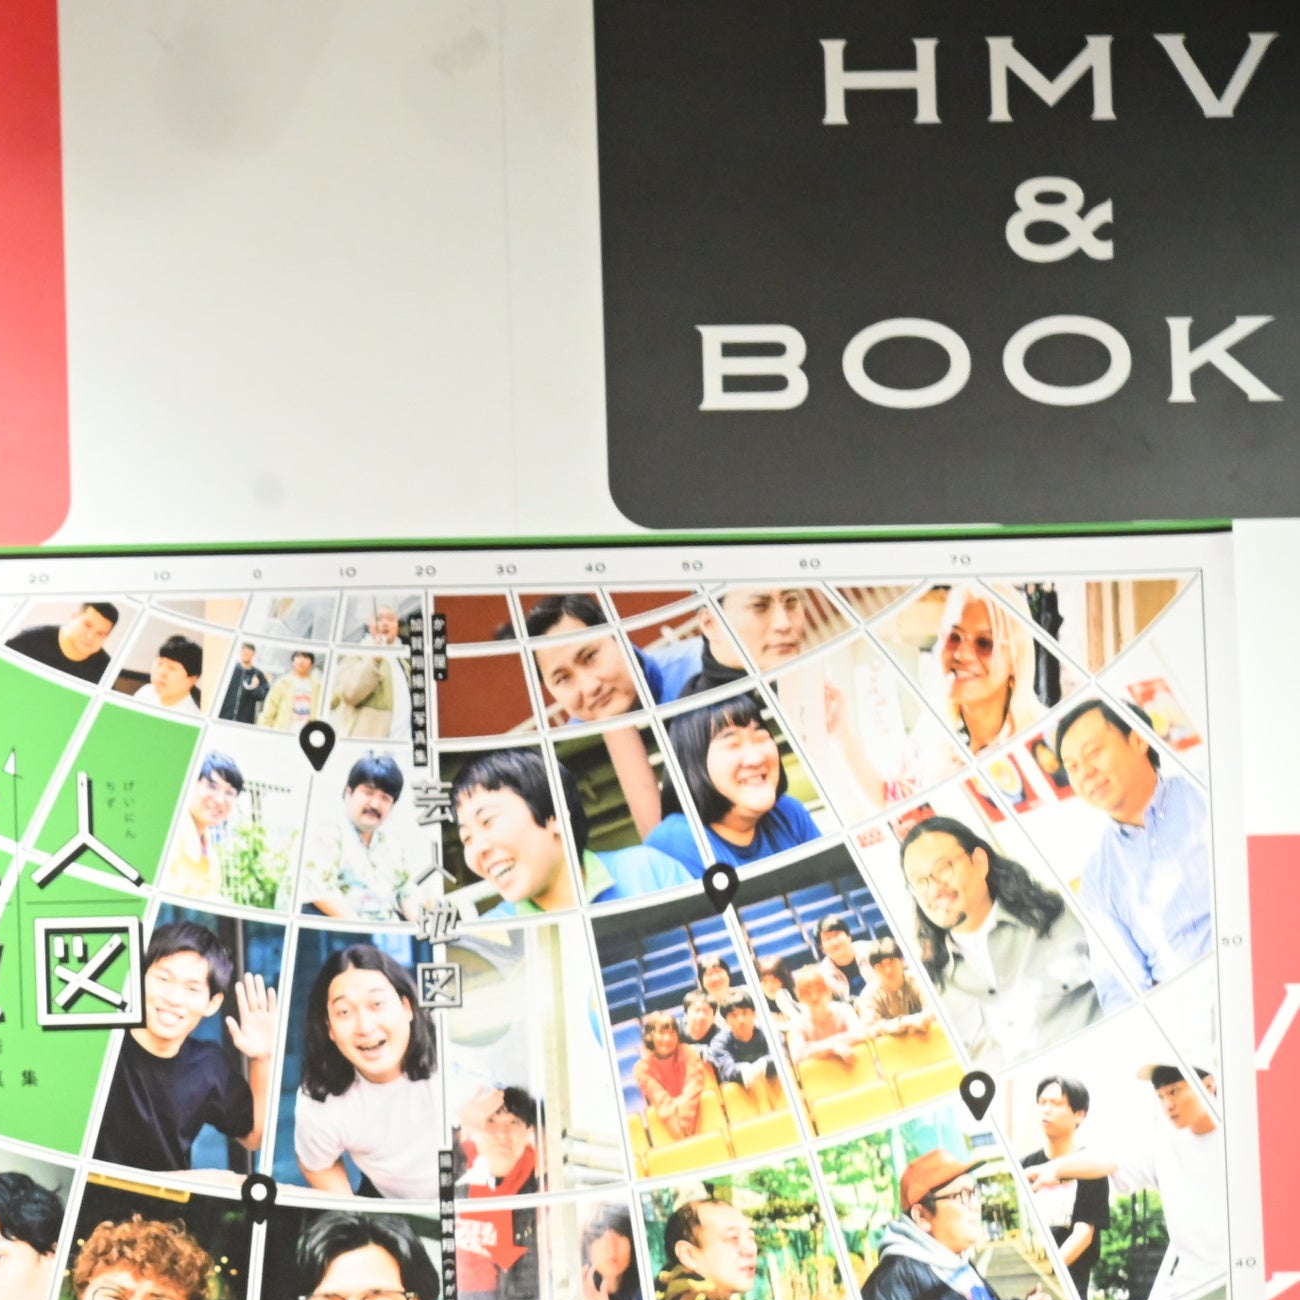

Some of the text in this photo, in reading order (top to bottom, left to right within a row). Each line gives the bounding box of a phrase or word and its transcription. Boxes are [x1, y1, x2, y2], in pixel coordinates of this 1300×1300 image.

[819, 31, 1280, 125] HMV
[1005, 176, 1114, 263] &
[411, 779, 464, 1009] 芸人地図
